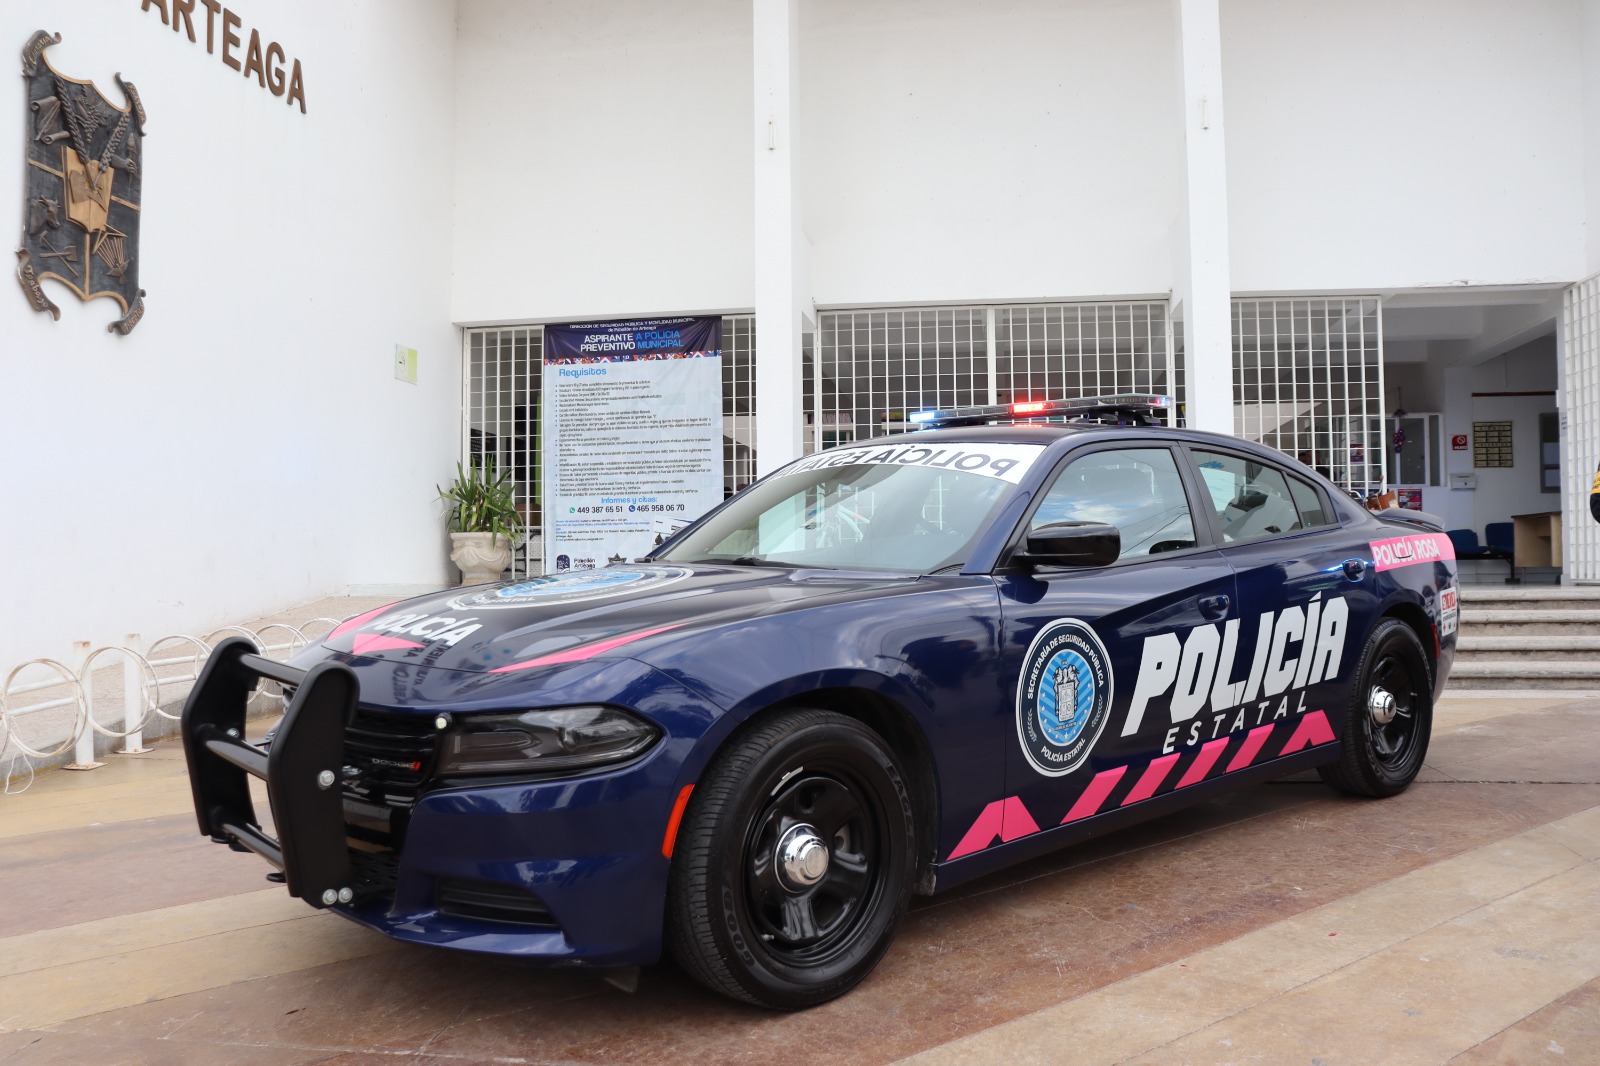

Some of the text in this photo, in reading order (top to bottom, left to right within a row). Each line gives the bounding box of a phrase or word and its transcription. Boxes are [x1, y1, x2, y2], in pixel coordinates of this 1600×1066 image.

[584, 330, 681, 343] ASPIRANTE A POLICIA
[580, 339, 684, 352] PREVENTIVO MUNICIPAL
[559, 367, 607, 378] Requisitos
[601, 496, 631, 504] Informes
[577, 506, 590, 514] 449
[615, 505, 623, 513] 51
[651, 504, 664, 512] 958
[1371, 537, 1441, 567] POLICÍA ROSA
[1028, 634, 1104, 700] SECRETARÍA DE SEGURIDAD PÚBLICA
[1120, 591, 1349, 738] POLICÍA
[1162, 691, 1307, 754] ESTATAL
[1041, 737, 1086, 763] POLICÍA ESTATAL
